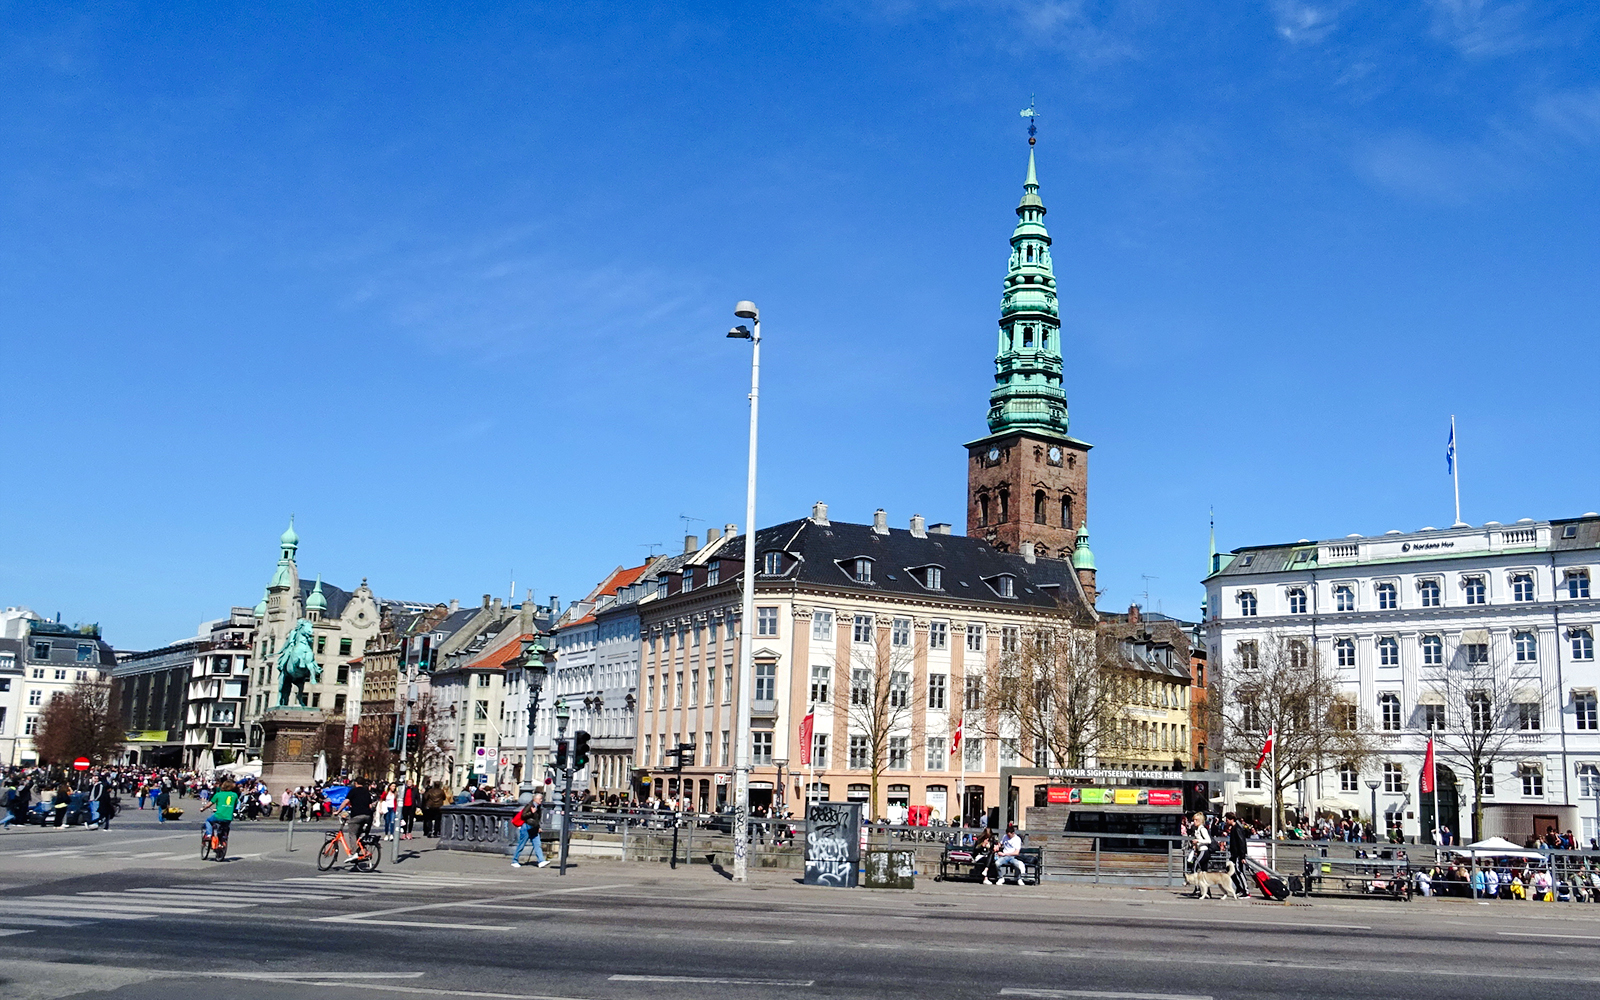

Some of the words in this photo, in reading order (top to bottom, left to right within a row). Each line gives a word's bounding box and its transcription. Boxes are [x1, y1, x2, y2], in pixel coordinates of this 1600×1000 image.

[1413, 543, 1439, 551] Nordens
[1048, 768, 1064, 776] BUY
[1065, 769, 1084, 777] YOUR
[1085, 769, 1133, 778] SIGHTSEEING
[1134, 770, 1162, 779] TICKETS
[1164, 771, 1183, 779] HERE
